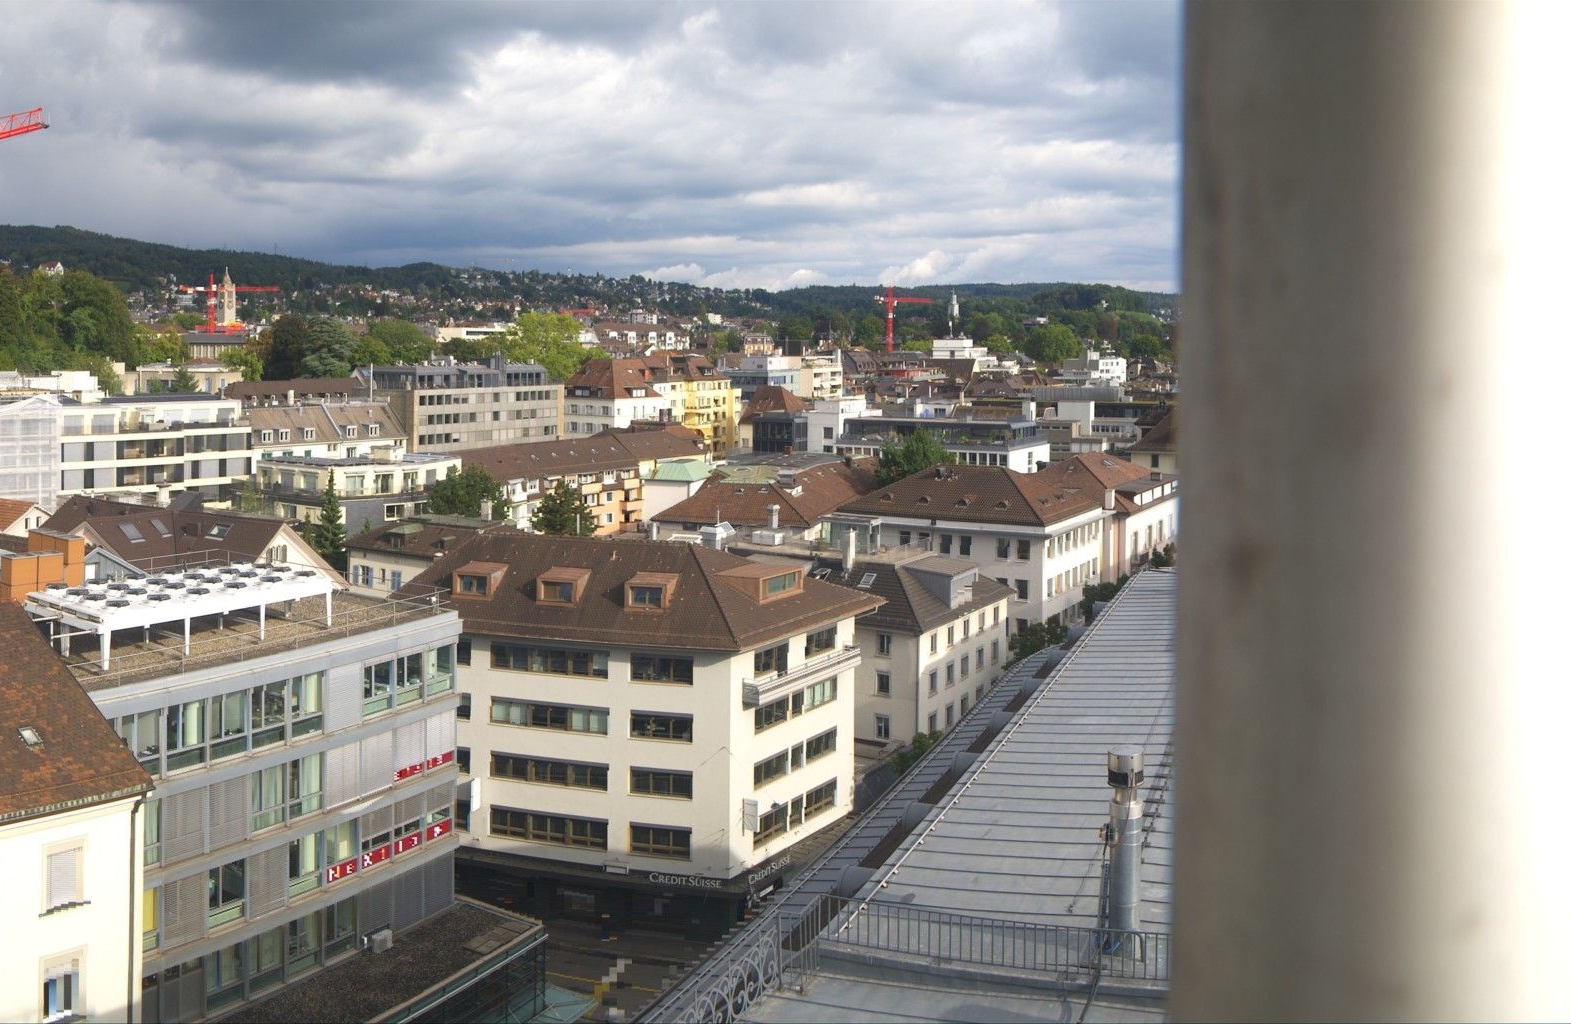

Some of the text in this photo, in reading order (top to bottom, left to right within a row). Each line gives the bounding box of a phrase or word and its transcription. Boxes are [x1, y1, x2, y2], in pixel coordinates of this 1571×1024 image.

[649, 872, 722, 889] CREDIT SUISSE
[748, 867, 771, 885] CREDIT
